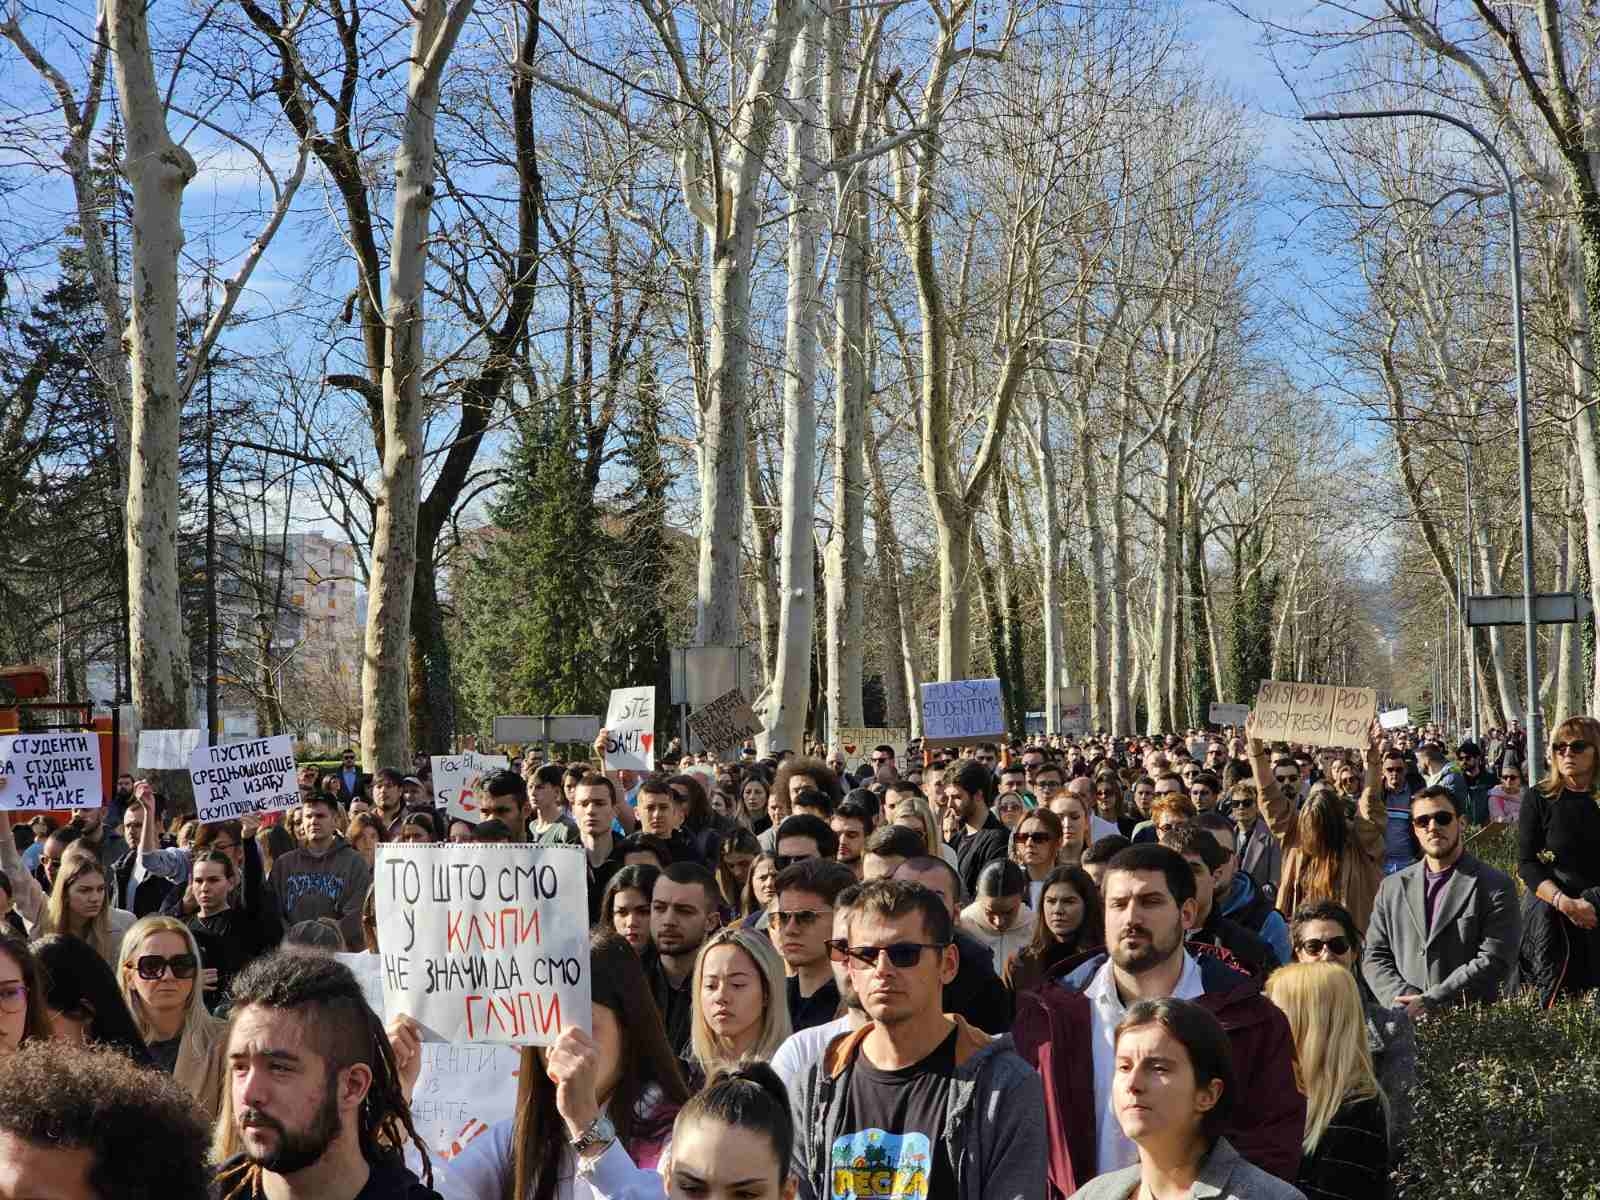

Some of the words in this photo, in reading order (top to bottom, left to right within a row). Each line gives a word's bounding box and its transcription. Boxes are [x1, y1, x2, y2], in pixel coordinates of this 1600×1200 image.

[923, 696, 1000, 718] STUDENTIMA
[1337, 688, 1369, 710] POD
[12, 737, 88, 755] СТУДЕНТИ
[209, 740, 270, 762] ПУСТИТЕ
[26, 757, 94, 774] СТУДЕНТЕ
[192, 755, 293, 785] СРЕДЊОШКОЛЦЕ
[24, 775, 66, 797] ЂАЦИ
[209, 785, 231, 803] ДА
[243, 774, 284, 794] ИЗАЂУ
[16, 793, 36, 807] ЗА
[41, 788, 85, 810] ЂАКЕ
[385, 858, 421, 904] ТО
[432, 863, 486, 902] ШТО
[498, 864, 558, 902] СМО
[403, 908, 415, 952] У
[447, 906, 541, 952] КЛУПИ
[384, 954, 409, 991] НЕ
[424, 955, 488, 994] ЗНАЧИ
[492, 956, 522, 993] ДА
[533, 958, 581, 986] СМО
[464, 992, 561, 1040] ГЛУПИ
